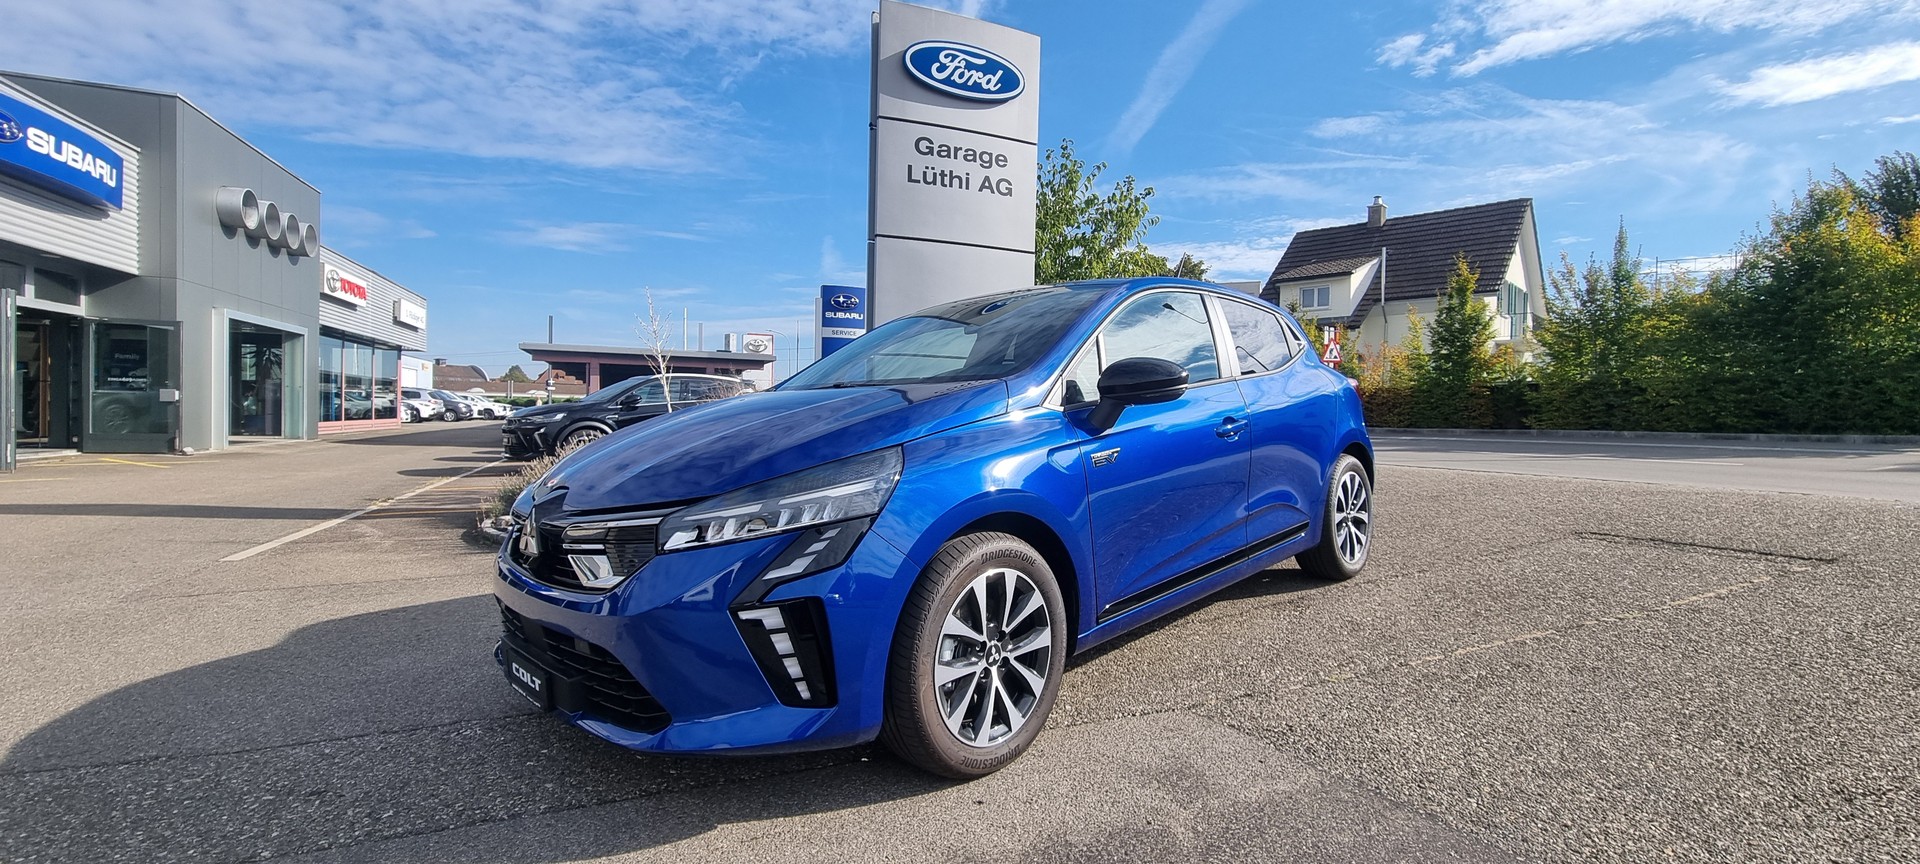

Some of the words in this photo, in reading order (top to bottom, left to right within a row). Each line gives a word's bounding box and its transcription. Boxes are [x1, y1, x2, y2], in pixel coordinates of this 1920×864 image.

[931, 50, 1003, 91] Ford
[27, 127, 116, 187] SUBARU
[914, 136, 1008, 169] Garage
[907, 164, 970, 190] Lüthi
[978, 175, 1013, 197] AG
[340, 277, 367, 301] TOYOTA
[825, 311, 863, 320] SUBARU
[981, 549, 1037, 567] BRIDGESTONE
[512, 662, 541, 691] COLT
[959, 744, 1020, 769] BRIDGESTONE
